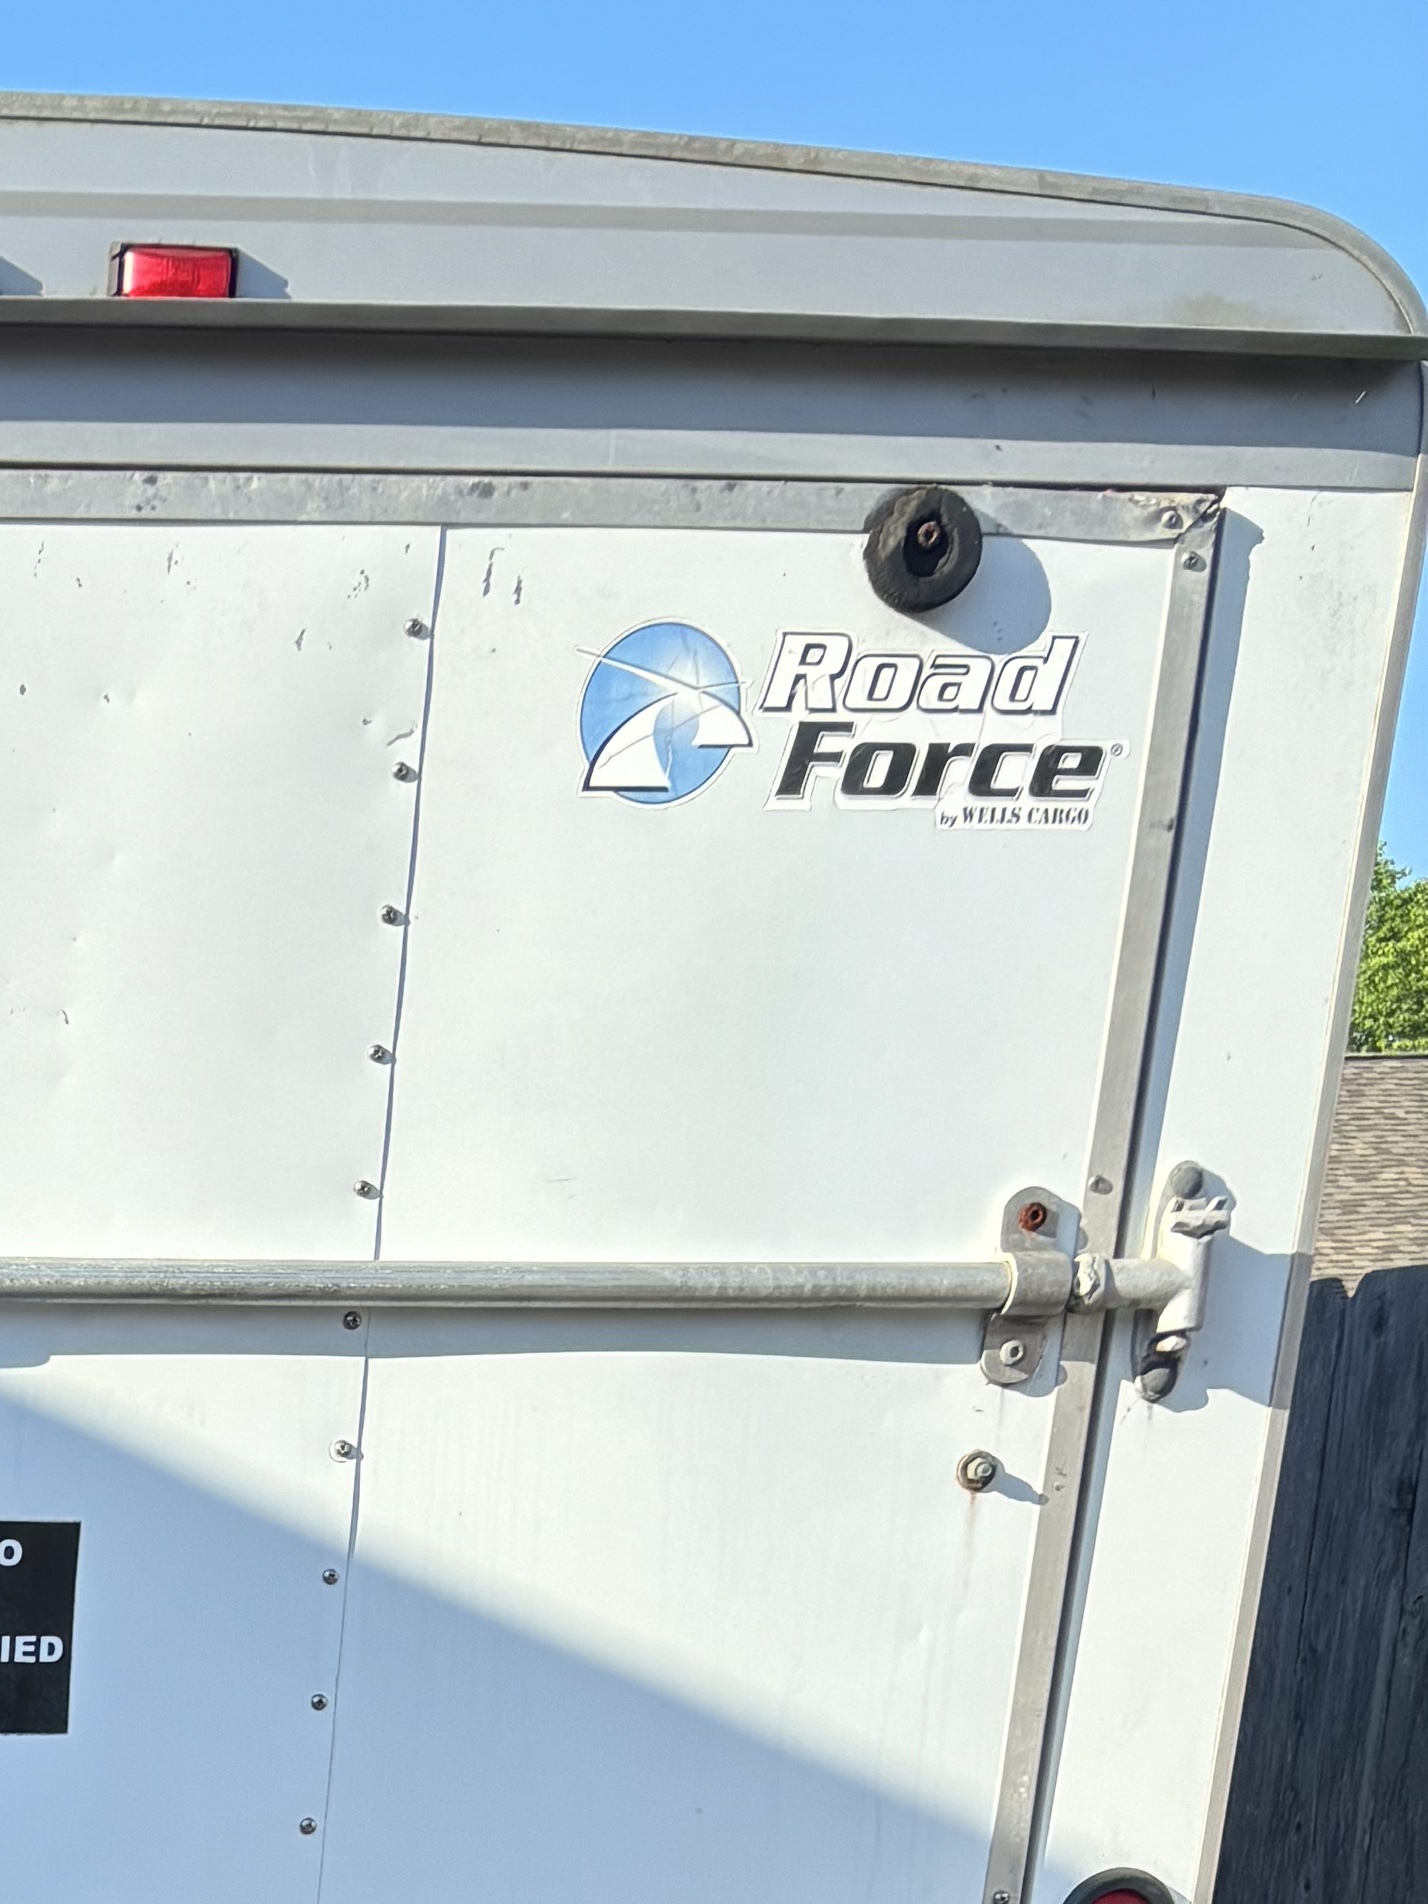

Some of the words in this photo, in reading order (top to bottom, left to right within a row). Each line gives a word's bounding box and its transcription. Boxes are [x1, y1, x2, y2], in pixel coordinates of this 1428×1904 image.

[760, 631, 1080, 714] Road
[939, 811, 958, 827] by
[960, 807, 1021, 826] WELLS
[1027, 807, 1090, 826] CARGO
